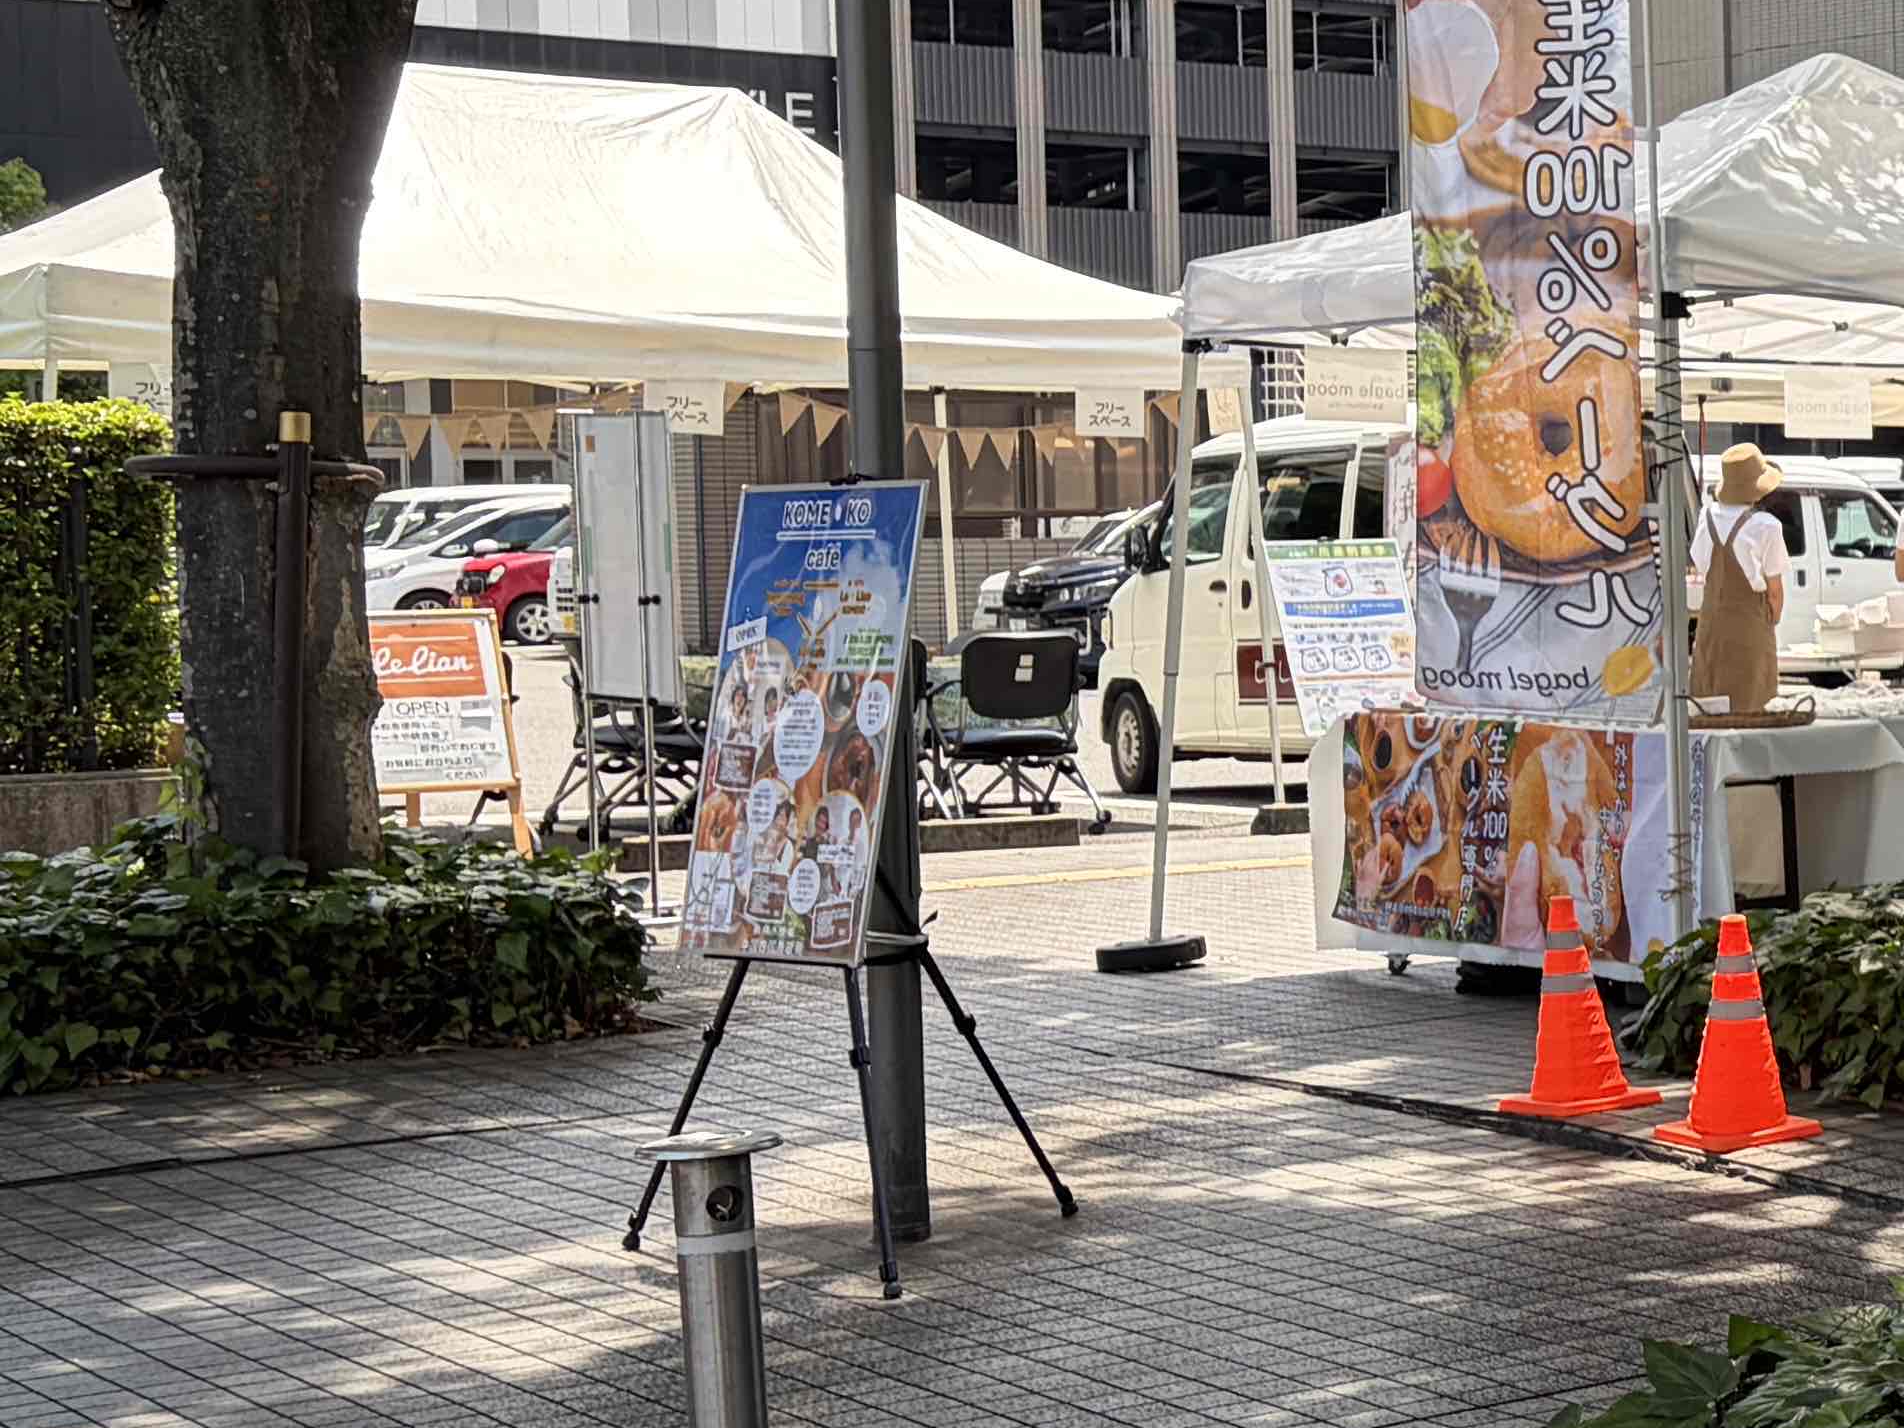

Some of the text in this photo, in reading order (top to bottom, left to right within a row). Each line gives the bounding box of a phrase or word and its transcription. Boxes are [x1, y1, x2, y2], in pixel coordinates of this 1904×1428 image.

[666, 396, 702, 409] フリー
[1095, 402, 1125, 413] フリー
[664, 410, 710, 424] ペース
[1088, 415, 1131, 427] スペース
[782, 498, 872, 527] KOME KO
[396, 701, 450, 716] OPEN
